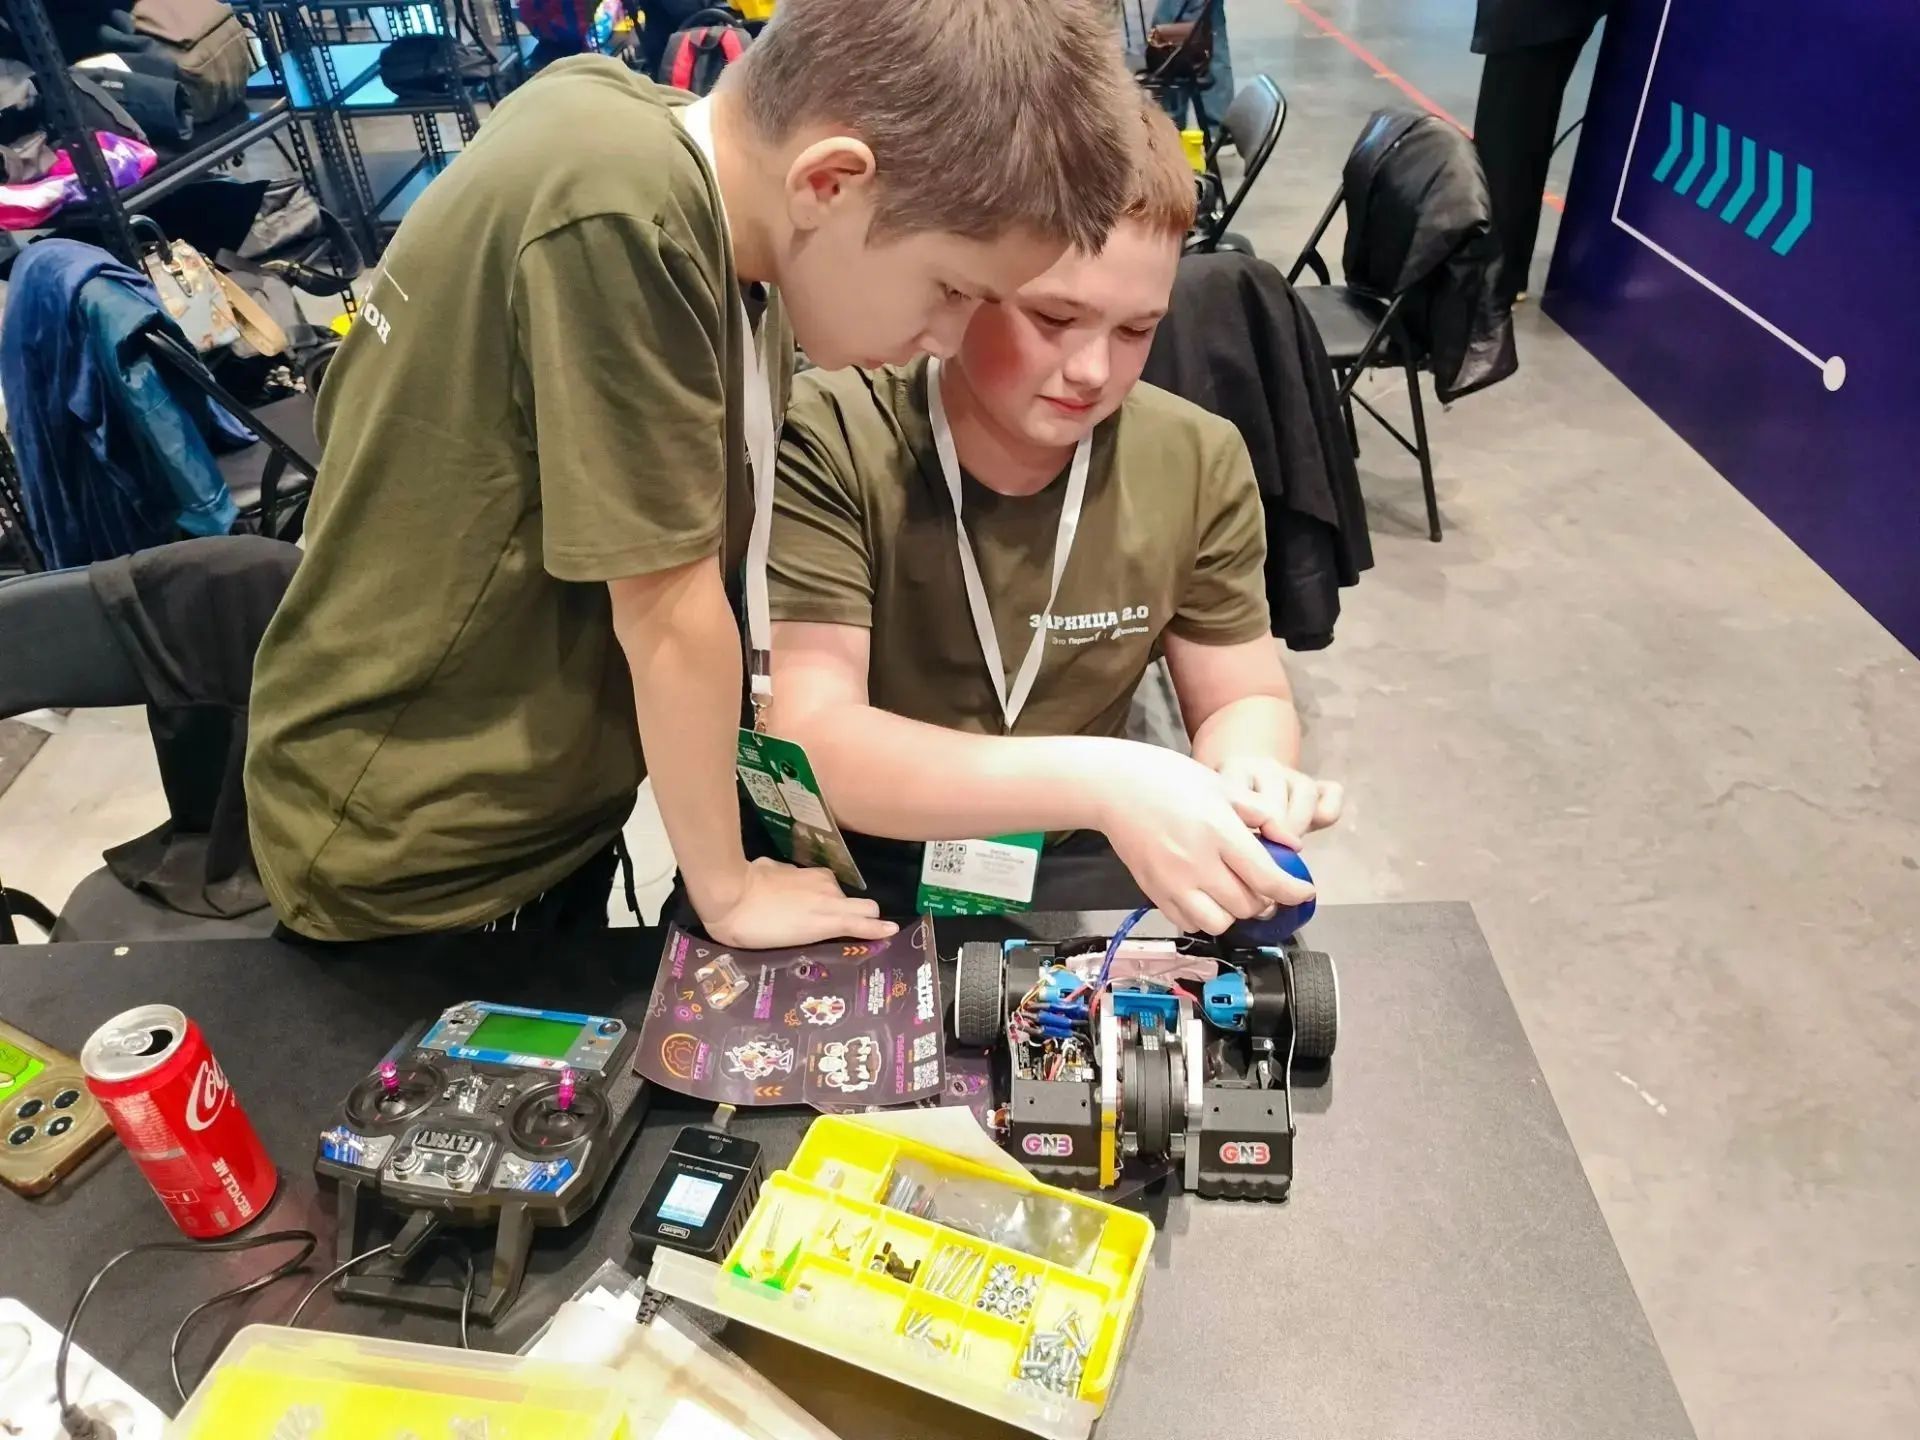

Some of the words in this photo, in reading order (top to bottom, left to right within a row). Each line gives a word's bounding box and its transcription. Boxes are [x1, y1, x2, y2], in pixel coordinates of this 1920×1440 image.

[1029, 611, 1118, 631] ЗАРНИЦА
[1122, 605, 1149, 620] 2.0
[416, 1131, 475, 1152] FLYSKY
[211, 1156, 231, 1177] ME
[221, 1173, 254, 1218] RECYCLE
